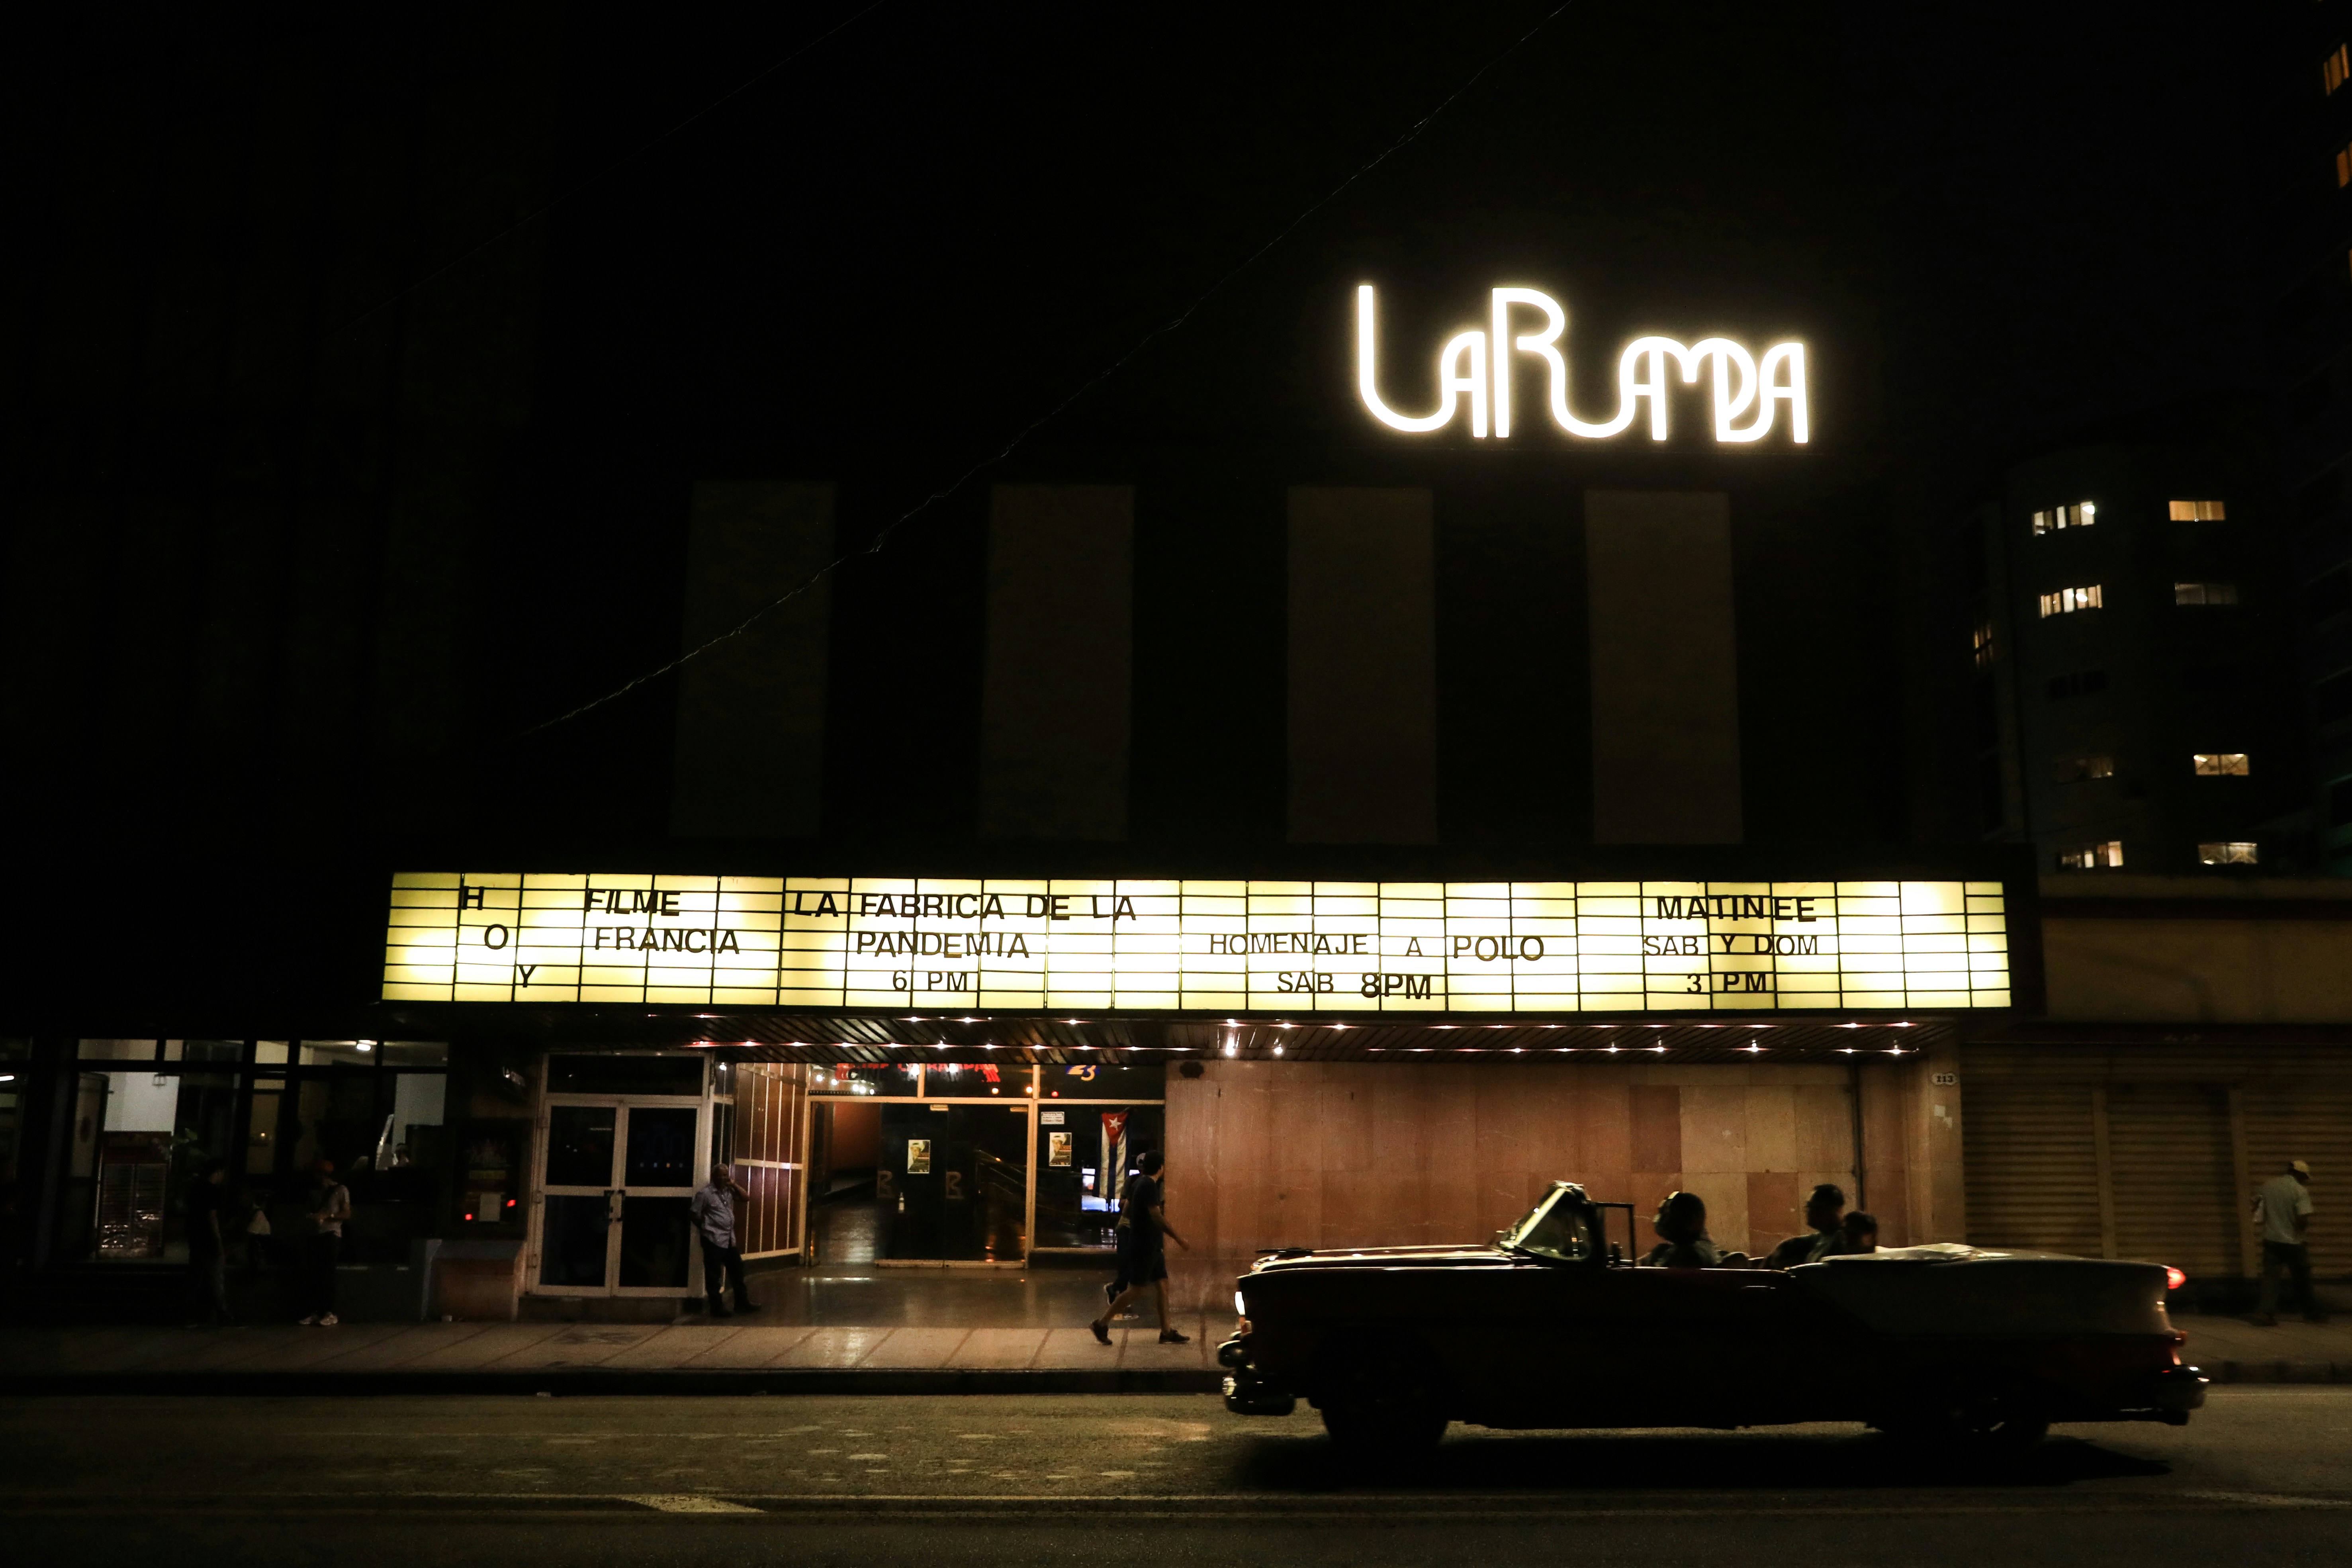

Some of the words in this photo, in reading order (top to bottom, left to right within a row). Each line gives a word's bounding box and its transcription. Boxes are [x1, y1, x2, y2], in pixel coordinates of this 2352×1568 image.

[585, 889, 681, 916] FILME
[794, 892, 838, 917] LA
[861, 893, 1005, 919] FABRICA
[1026, 895, 1070, 920] DE
[1092, 895, 1136, 920] LA
[1657, 895, 1817, 922] MATINEE
[596, 927, 740, 955] FRANCIA
[857, 931, 1029, 958] PANDEMIA
[1210, 933, 1370, 955] HOMENAJE
[1406, 937, 1423, 956] A
[1452, 936, 1544, 961] POLO
[1644, 935, 1699, 956] SAB
[1721, 935, 1736, 954] Y
[1754, 935, 1818, 956] DOM
[892, 970, 907, 991] 6
[928, 972, 968, 992] PM
[1277, 971, 1334, 993] SAB
[1361, 972, 1431, 1000] 8PM
[1687, 973, 1702, 994] 3
[1723, 973, 1767, 992] PM
